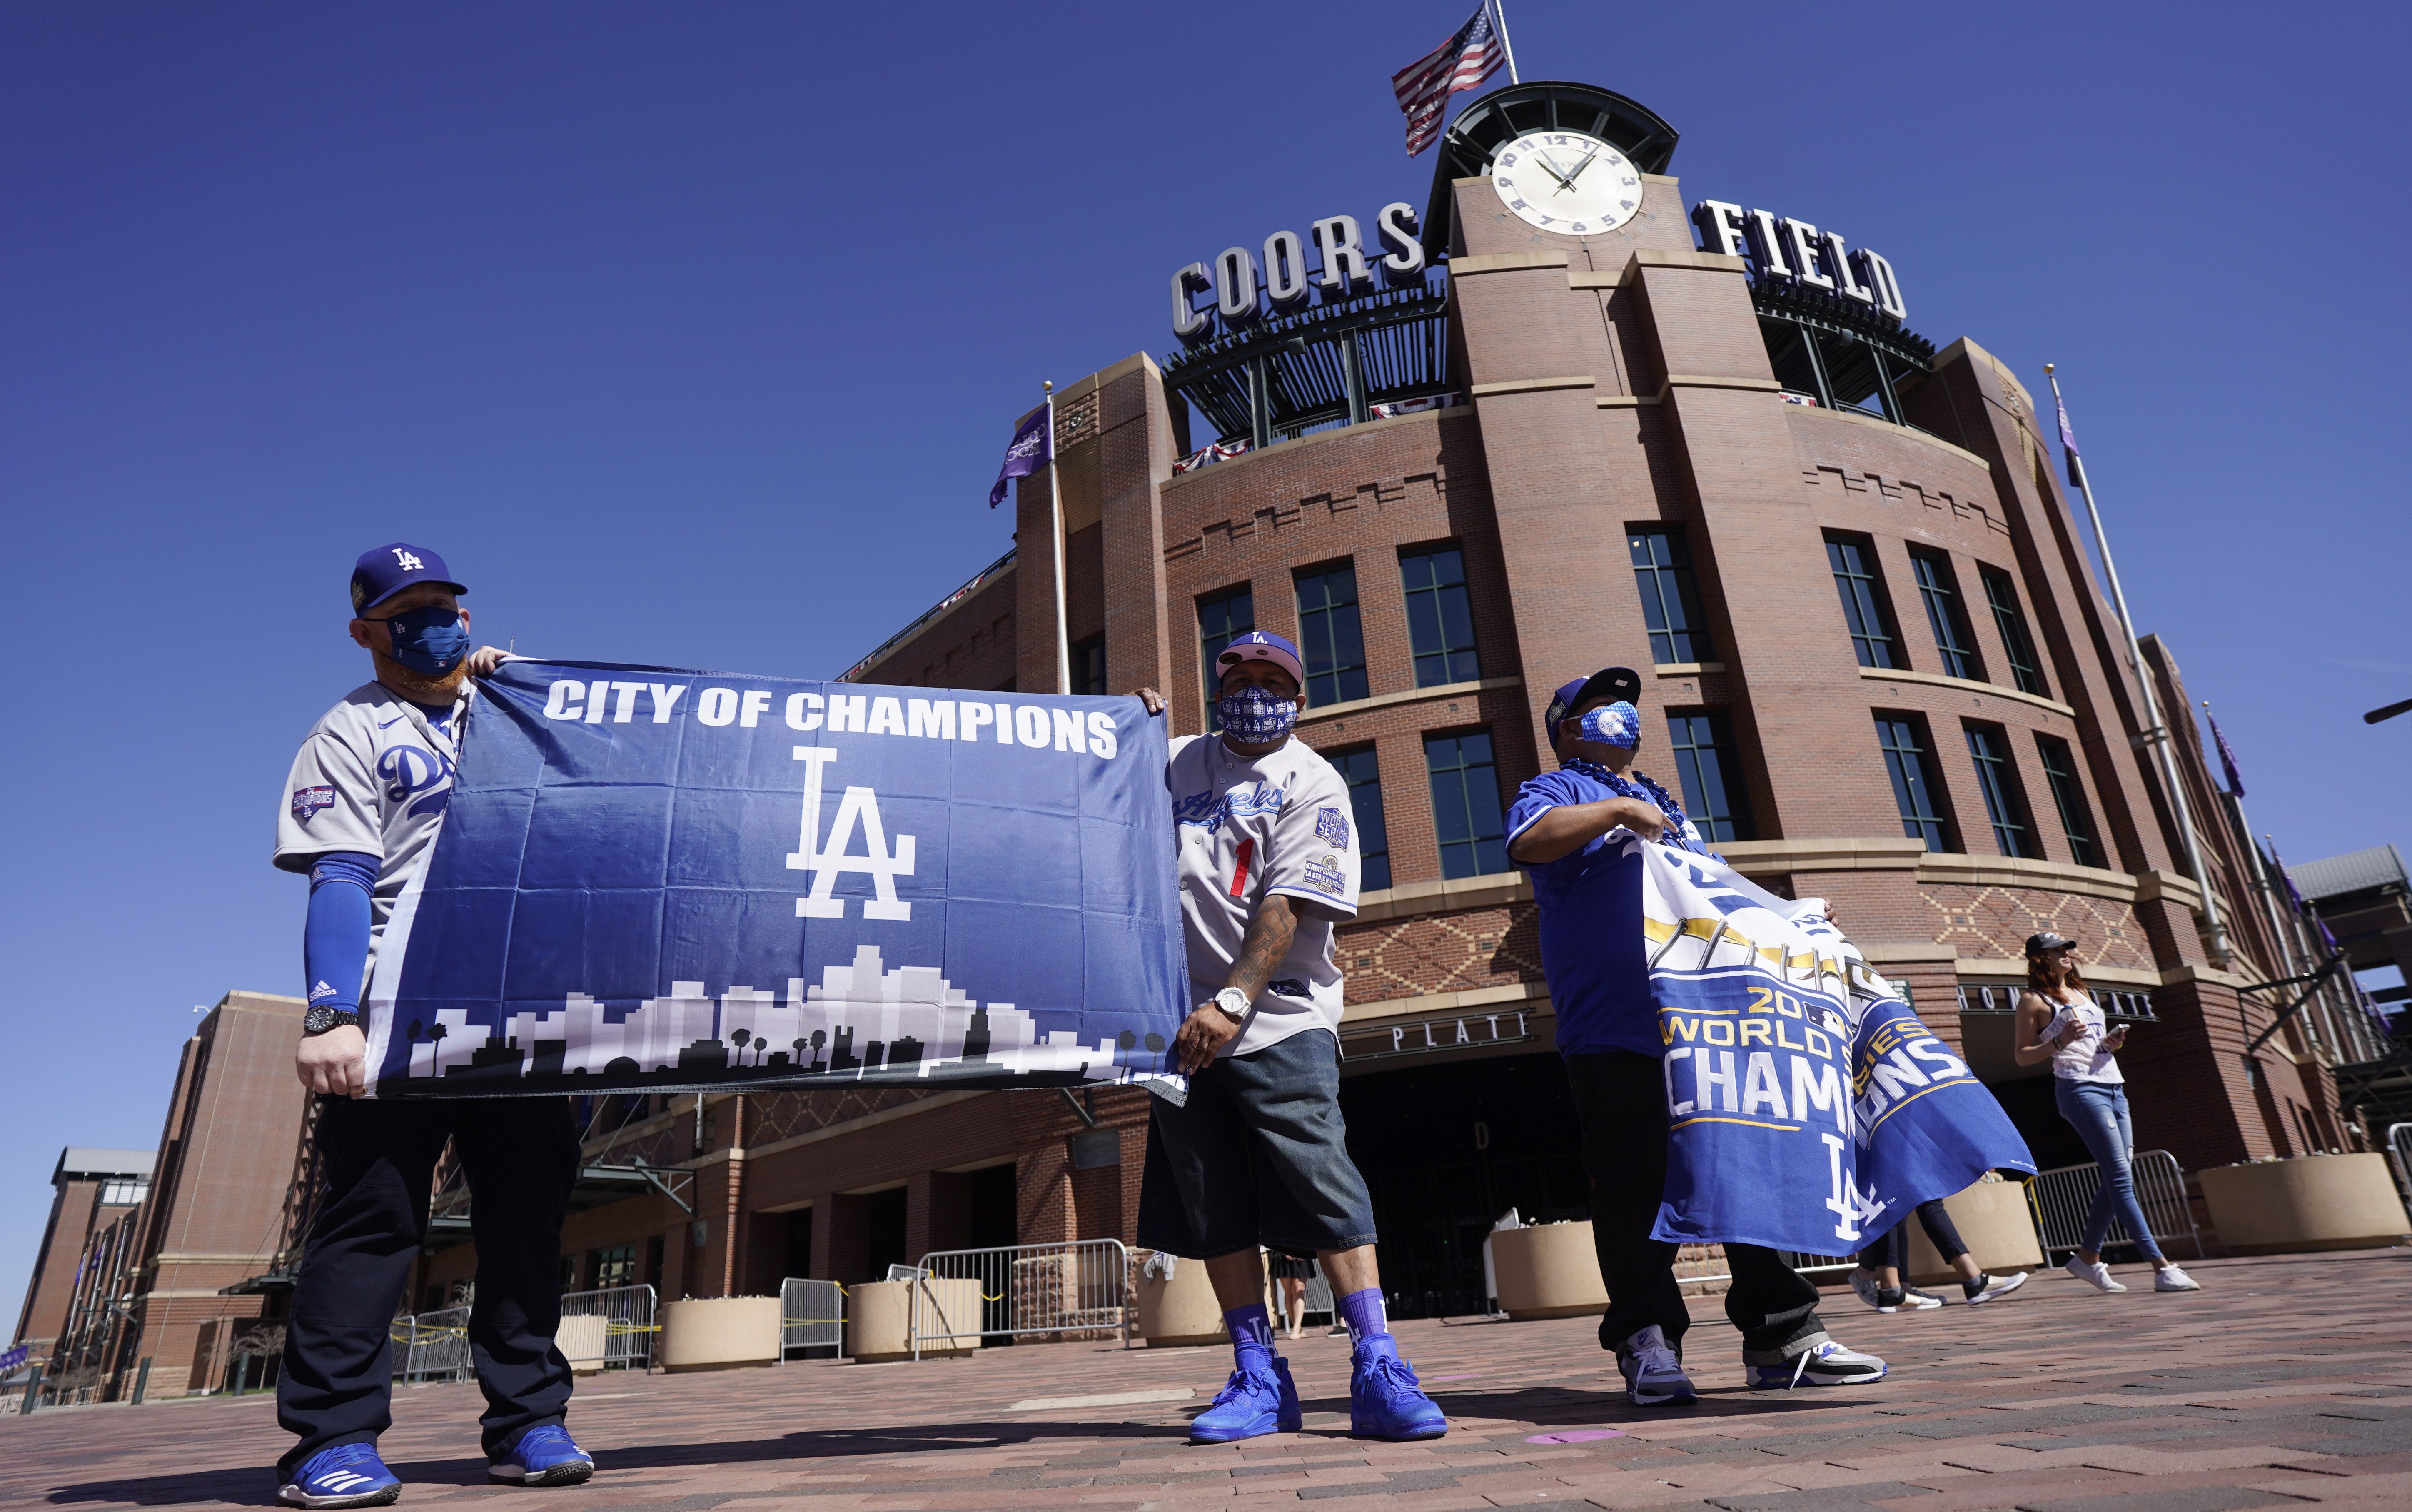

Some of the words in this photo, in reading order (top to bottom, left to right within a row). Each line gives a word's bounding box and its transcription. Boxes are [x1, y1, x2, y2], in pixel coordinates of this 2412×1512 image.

[1517, 140, 1535, 151] 11
[1544, 135, 1567, 145] 12
[1582, 139, 1591, 149] 1
[1500, 153, 1517, 168] 10
[1606, 155, 1622, 166] 2
[1499, 177, 1513, 187] 9
[1622, 177, 1636, 186] 3
[1511, 199, 1527, 210] 8
[1620, 199, 1634, 210] 4
[1539, 215, 1554, 225] 7
[1601, 215, 1616, 226] 5
[1572, 222, 1586, 232] 6
[1170, 202, 1425, 344] COORS
[1704, 200, 1907, 322] FIELD
[392, 548, 424, 571] LA
[394, 622, 407, 634] LA
[1234, 702, 1241, 714] LA
[1266, 703, 1274, 715] LA
[543, 679, 687, 724] CITY
[697, 687, 772, 728] OF
[786, 692, 1117, 759] CHAMPIONS
[1244, 719, 1251, 731] LA
[1253, 719, 1261, 731] LA
[1277, 718, 1284, 730] LA
[1178, 779, 1284, 834] Angeles
[1320, 811, 1348, 834] WORLD
[786, 746, 915, 921] LA
[1318, 822, 1347, 845] SERIES
[1230, 838, 1254, 898] 1
[1307, 862, 1338, 880] CAMPEONES
[1339, 874, 1346, 883] DE
[1312, 872, 1326, 882] SERIE
[1325, 876, 1344, 891] MUNDIAL
[1392, 1012, 1530, 1052] PLATE
[1657, 1015, 1833, 1060] WORLD
[1474, 1122, 1490, 1150] D
[1821, 1132, 1887, 1241] LA
[1887, 1196, 1897, 1205] TM
[1637, 1330, 1649, 1340] NIKE
